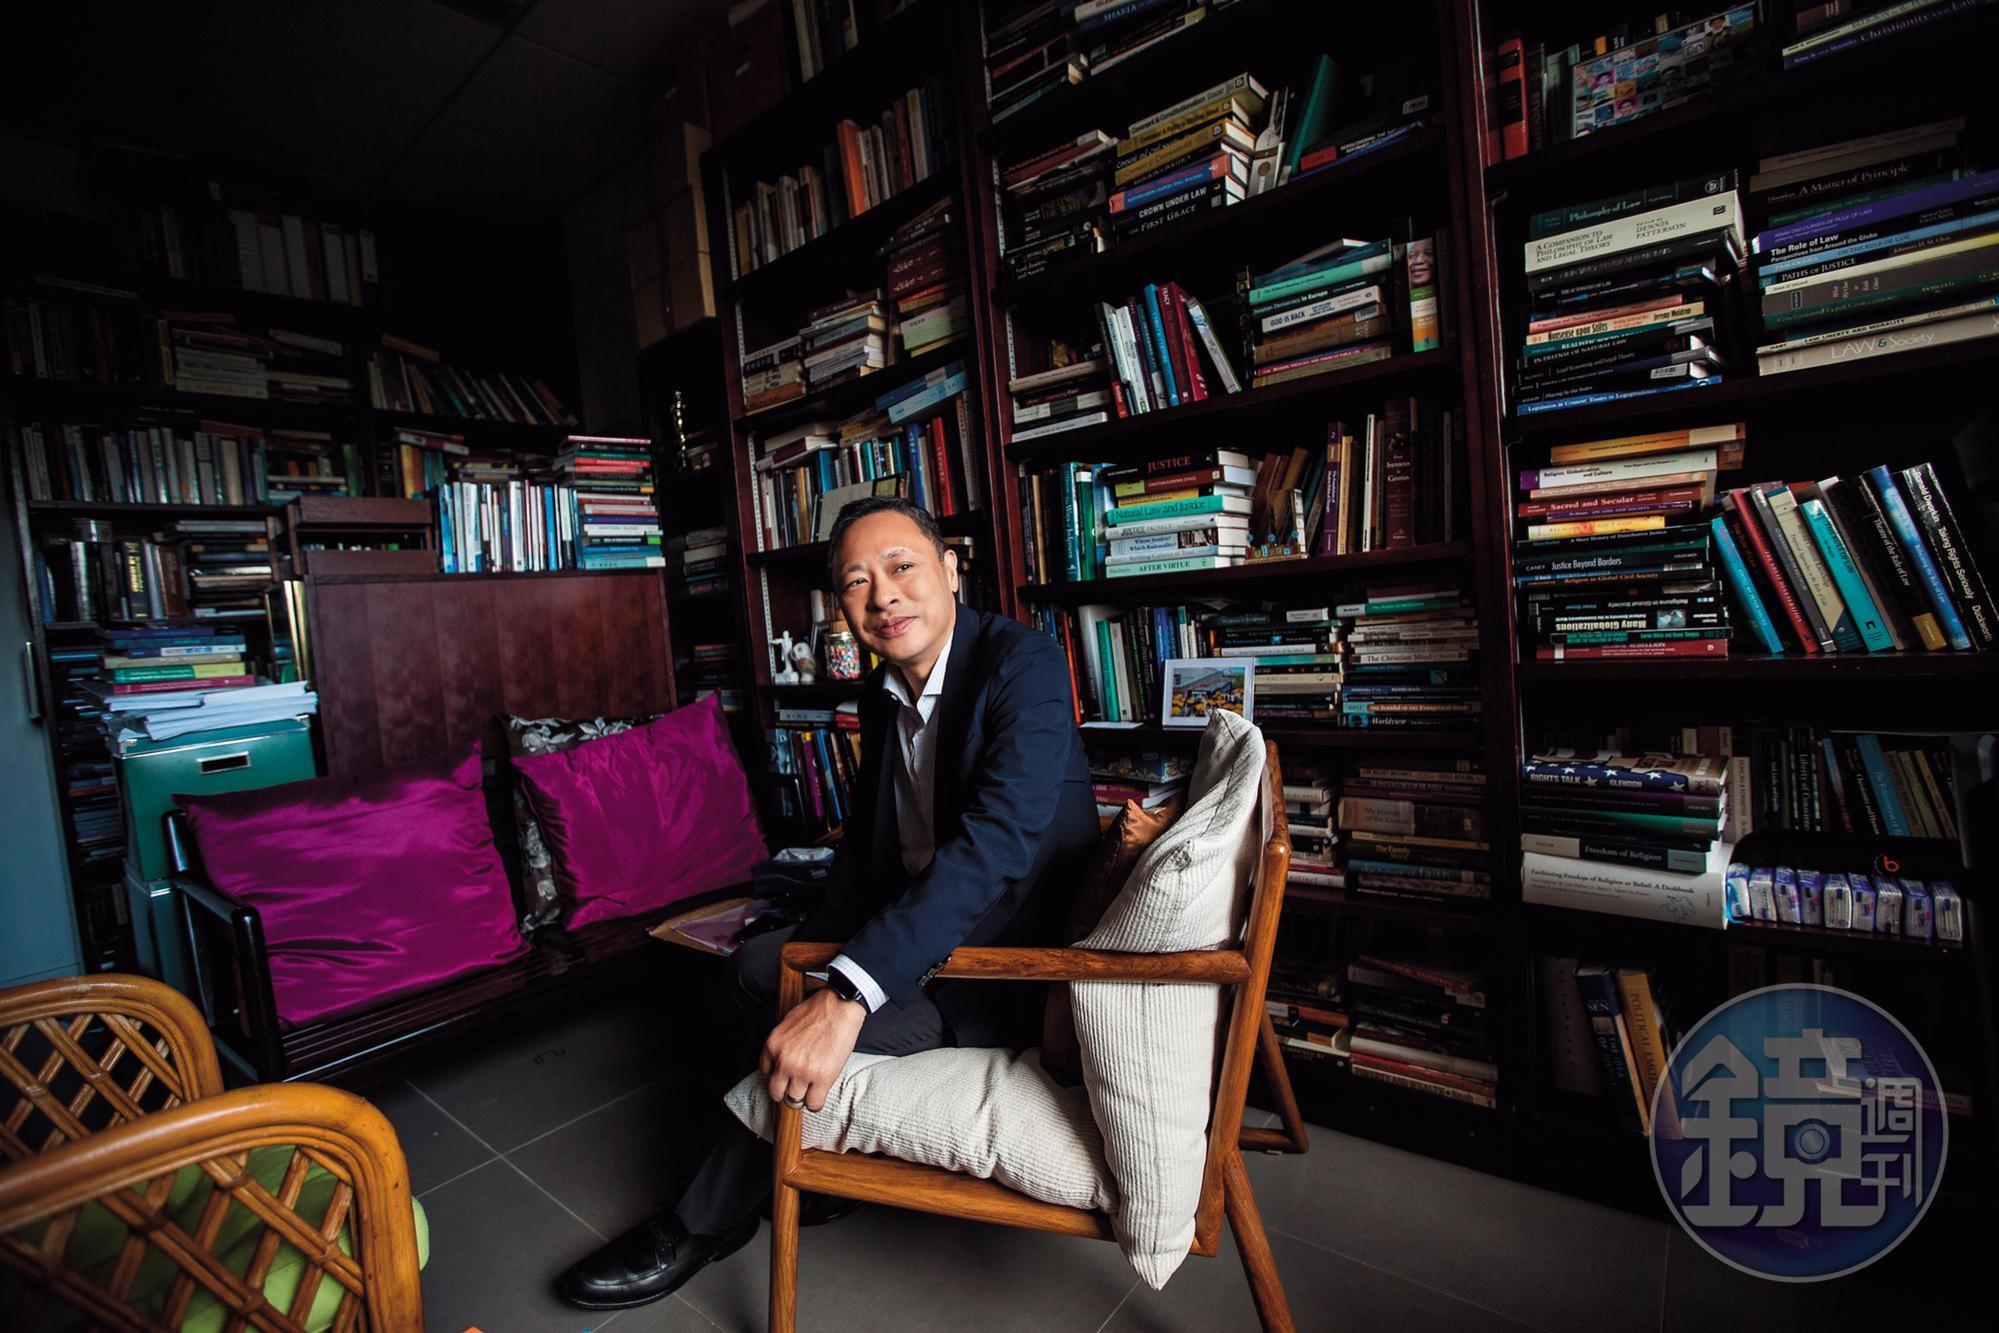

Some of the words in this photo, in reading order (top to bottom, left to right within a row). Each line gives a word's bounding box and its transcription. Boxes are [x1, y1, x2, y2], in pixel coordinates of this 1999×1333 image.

[1847, 173, 1858, 184] of
[1861, 163, 1911, 182] Principle
[1138, 202, 1164, 218] CROWN
[1164, 193, 1189, 208] UNDER
[1189, 186, 1207, 199] LAW
[1139, 215, 1164, 231] FIRST
[1166, 202, 1197, 221] GRACE
[1636, 221, 1669, 233] DENNIS
[1636, 222, 1687, 240] PATTERSON
[1770, 246, 1786, 256] The
[1786, 241, 1806, 253] Rule
[1806, 237, 1818, 247] of
[1818, 232, 1840, 244] Law
[1780, 267, 1808, 282] PATHS
[1820, 255, 1856, 272] JUSTICE
[1269, 316, 1283, 326] GOD
[1283, 314, 1289, 322] IS
[1290, 310, 1306, 321] BACK
[1548, 328, 1575, 341] Nonsense
[1575, 326, 1591, 338] upon
[1829, 337, 1878, 359] LAW
[1876, 336, 1888, 348] &
[1887, 325, 1936, 351] Society
[1147, 455, 1192, 474] JUSTICE
[1115, 508, 1144, 520] Natural
[1144, 506, 1161, 516] Law
[1162, 504, 1178, 514] and
[1178, 502, 1206, 513] Justice
[1550, 500, 1580, 511] Sacred
[1581, 499, 1598, 509] and
[1600, 496, 1634, 506] Secular
[1922, 493, 1941, 523] Dworkin
[1935, 524, 1954, 549] Taking
[1873, 517, 1888, 540] Theatre
[1883, 537, 1892, 546] of
[1899, 572, 1911, 587] Law
[1944, 545, 1963, 571] Rights
[1138, 562, 1162, 573] AFTER
[1164, 560, 1191, 570] VIRTUE
[1551, 559, 1572, 571] Justice
[1573, 558, 1596, 570] Beyond
[1597, 556, 1622, 568] Borders
[1954, 566, 1976, 600] Seriously
[1555, 620, 1619, 631] Globalizations
[1620, 618, 1646, 628] Many
[1969, 602, 1995, 643] Duckworth
[1381, 654, 1412, 662] Christian
[1531, 773, 1559, 784] RIGHTS
[1560, 775, 1581, 785] TALK
[1609, 779, 1643, 788] GLENDON
[1584, 845, 1618, 856] Freedom
[1619, 849, 1628, 857] of
[1629, 851, 1663, 862] Religion
[1564, 872, 1589, 882] Freedom
[1598, 876, 1623, 886] Religion
[1661, 884, 1695, 894] Deskbook
